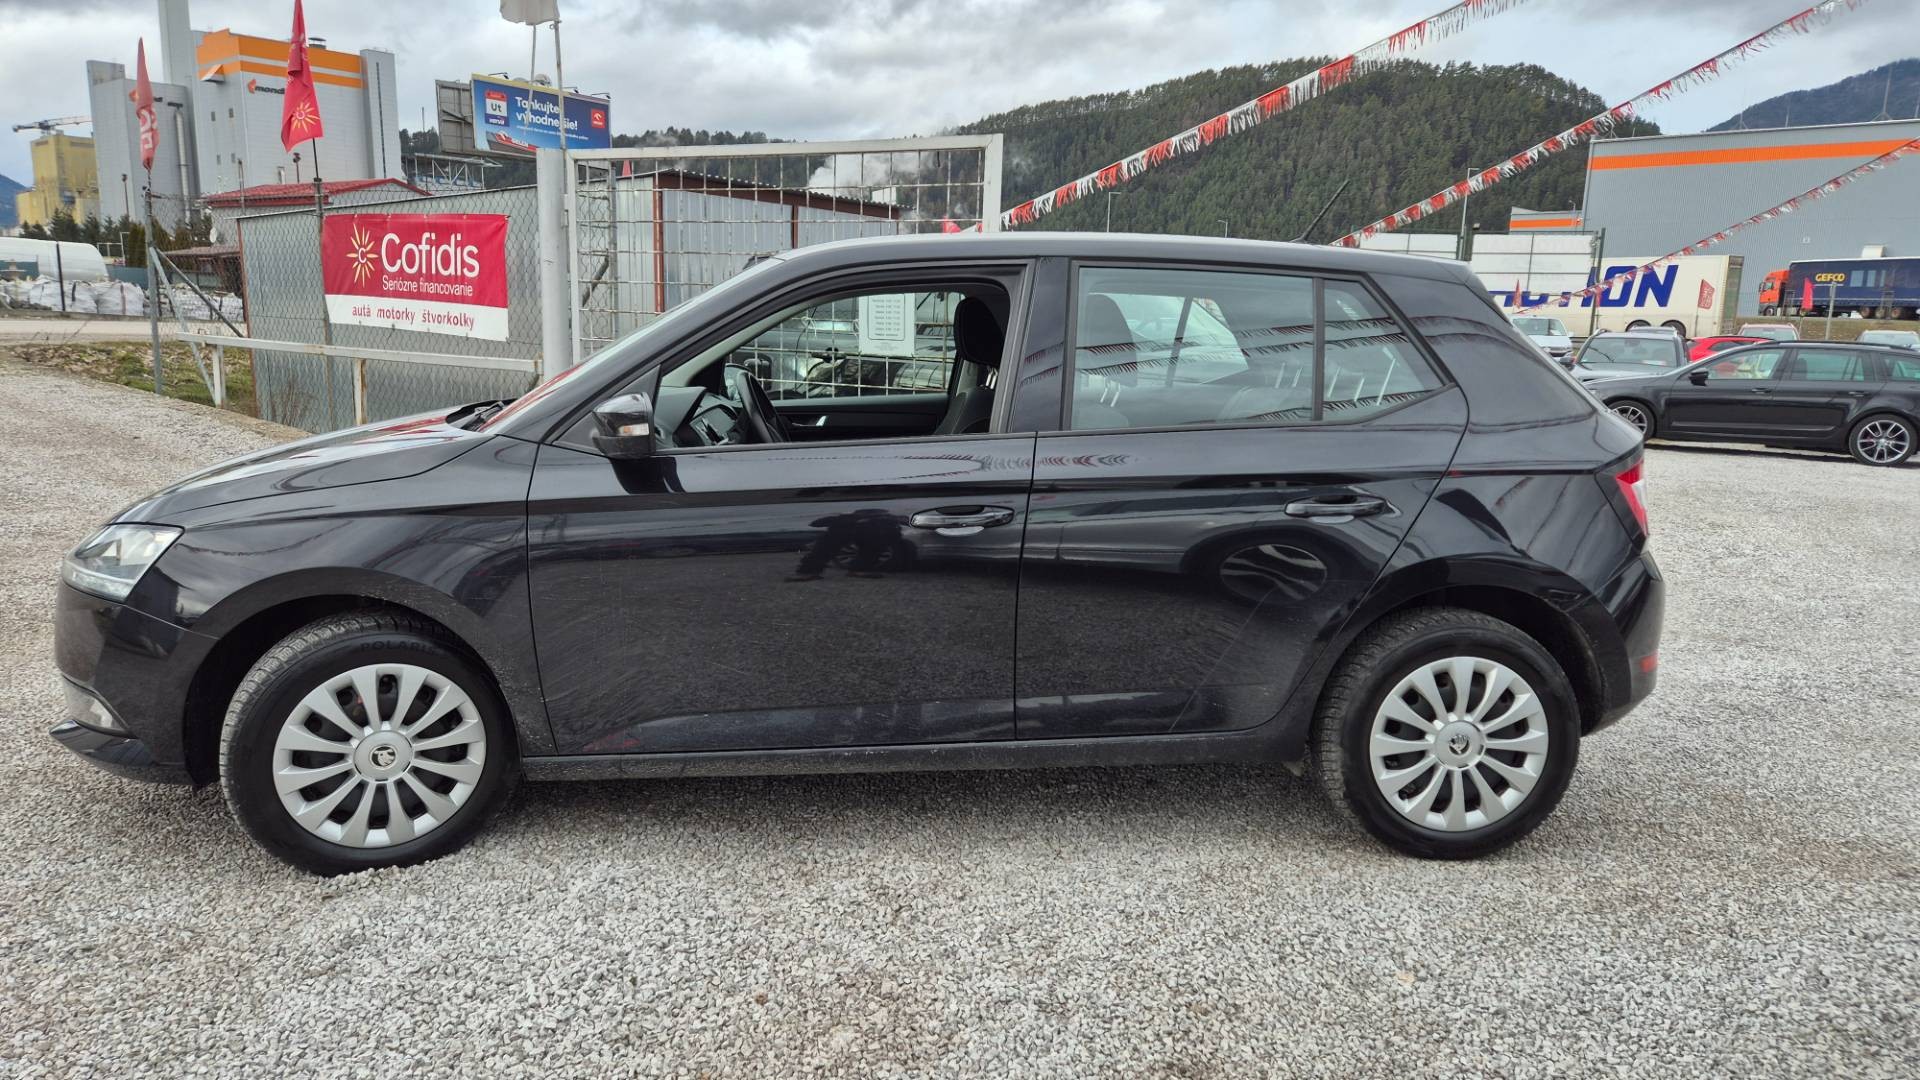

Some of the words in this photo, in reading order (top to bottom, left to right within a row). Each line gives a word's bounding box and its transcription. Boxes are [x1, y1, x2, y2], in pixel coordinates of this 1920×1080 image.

[255, 85, 285, 95] mond
[491, 103, 502, 113] Ut
[515, 97, 561, 114] Tankujte
[381, 232, 480, 278] Cofidis
[382, 275, 418, 292] Seriózne
[419, 279, 473, 296] financovanie
[1815, 272, 1846, 282] GEFCO
[352, 304, 372, 317] autá
[376, 307, 416, 324] motorky
[421, 309, 475, 331] štvorkolky
